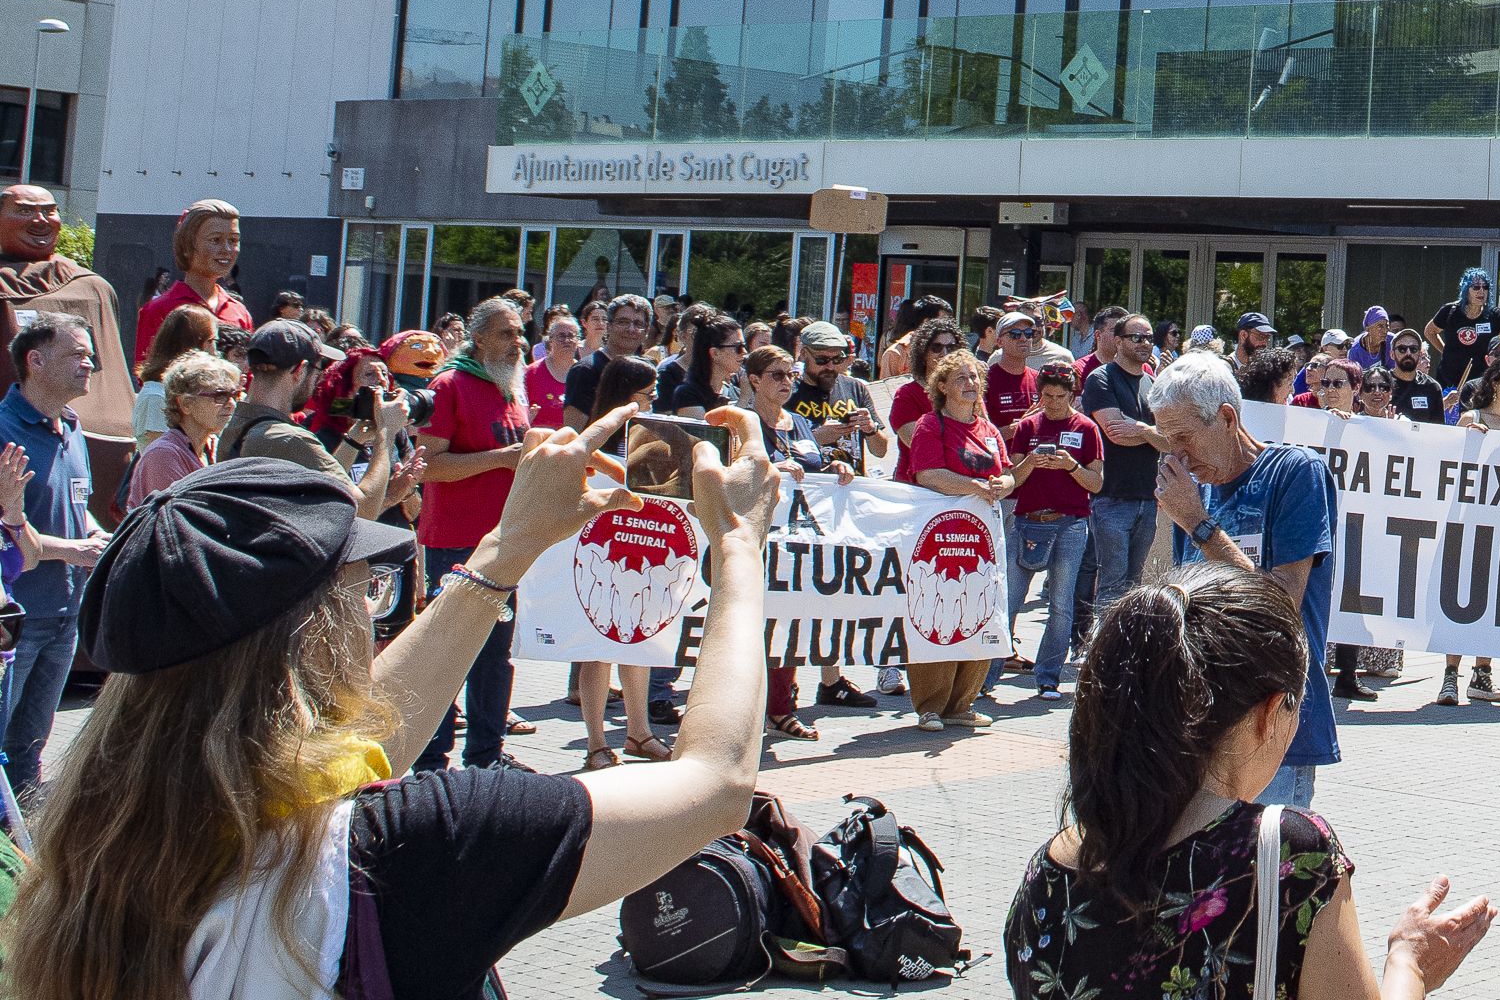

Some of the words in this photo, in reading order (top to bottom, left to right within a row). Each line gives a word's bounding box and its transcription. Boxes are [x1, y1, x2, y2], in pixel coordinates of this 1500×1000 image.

[512, 152, 642, 188] Ajuntament
[647, 150, 675, 181] de
[679, 151, 735, 181] Sant
[739, 151, 810, 189] Cugat
[1384, 455, 1421, 499] EL
[612, 514, 624, 526] EL
[626, 517, 677, 534] SENGLAR
[935, 533, 945, 542] EL
[946, 533, 980, 543] SENGLAR
[614, 531, 667, 548] CULTURAL
[939, 547, 976, 557] CULTURAL
[701, 541, 907, 595] LTURA
[764, 616, 909, 667] LLUITA
